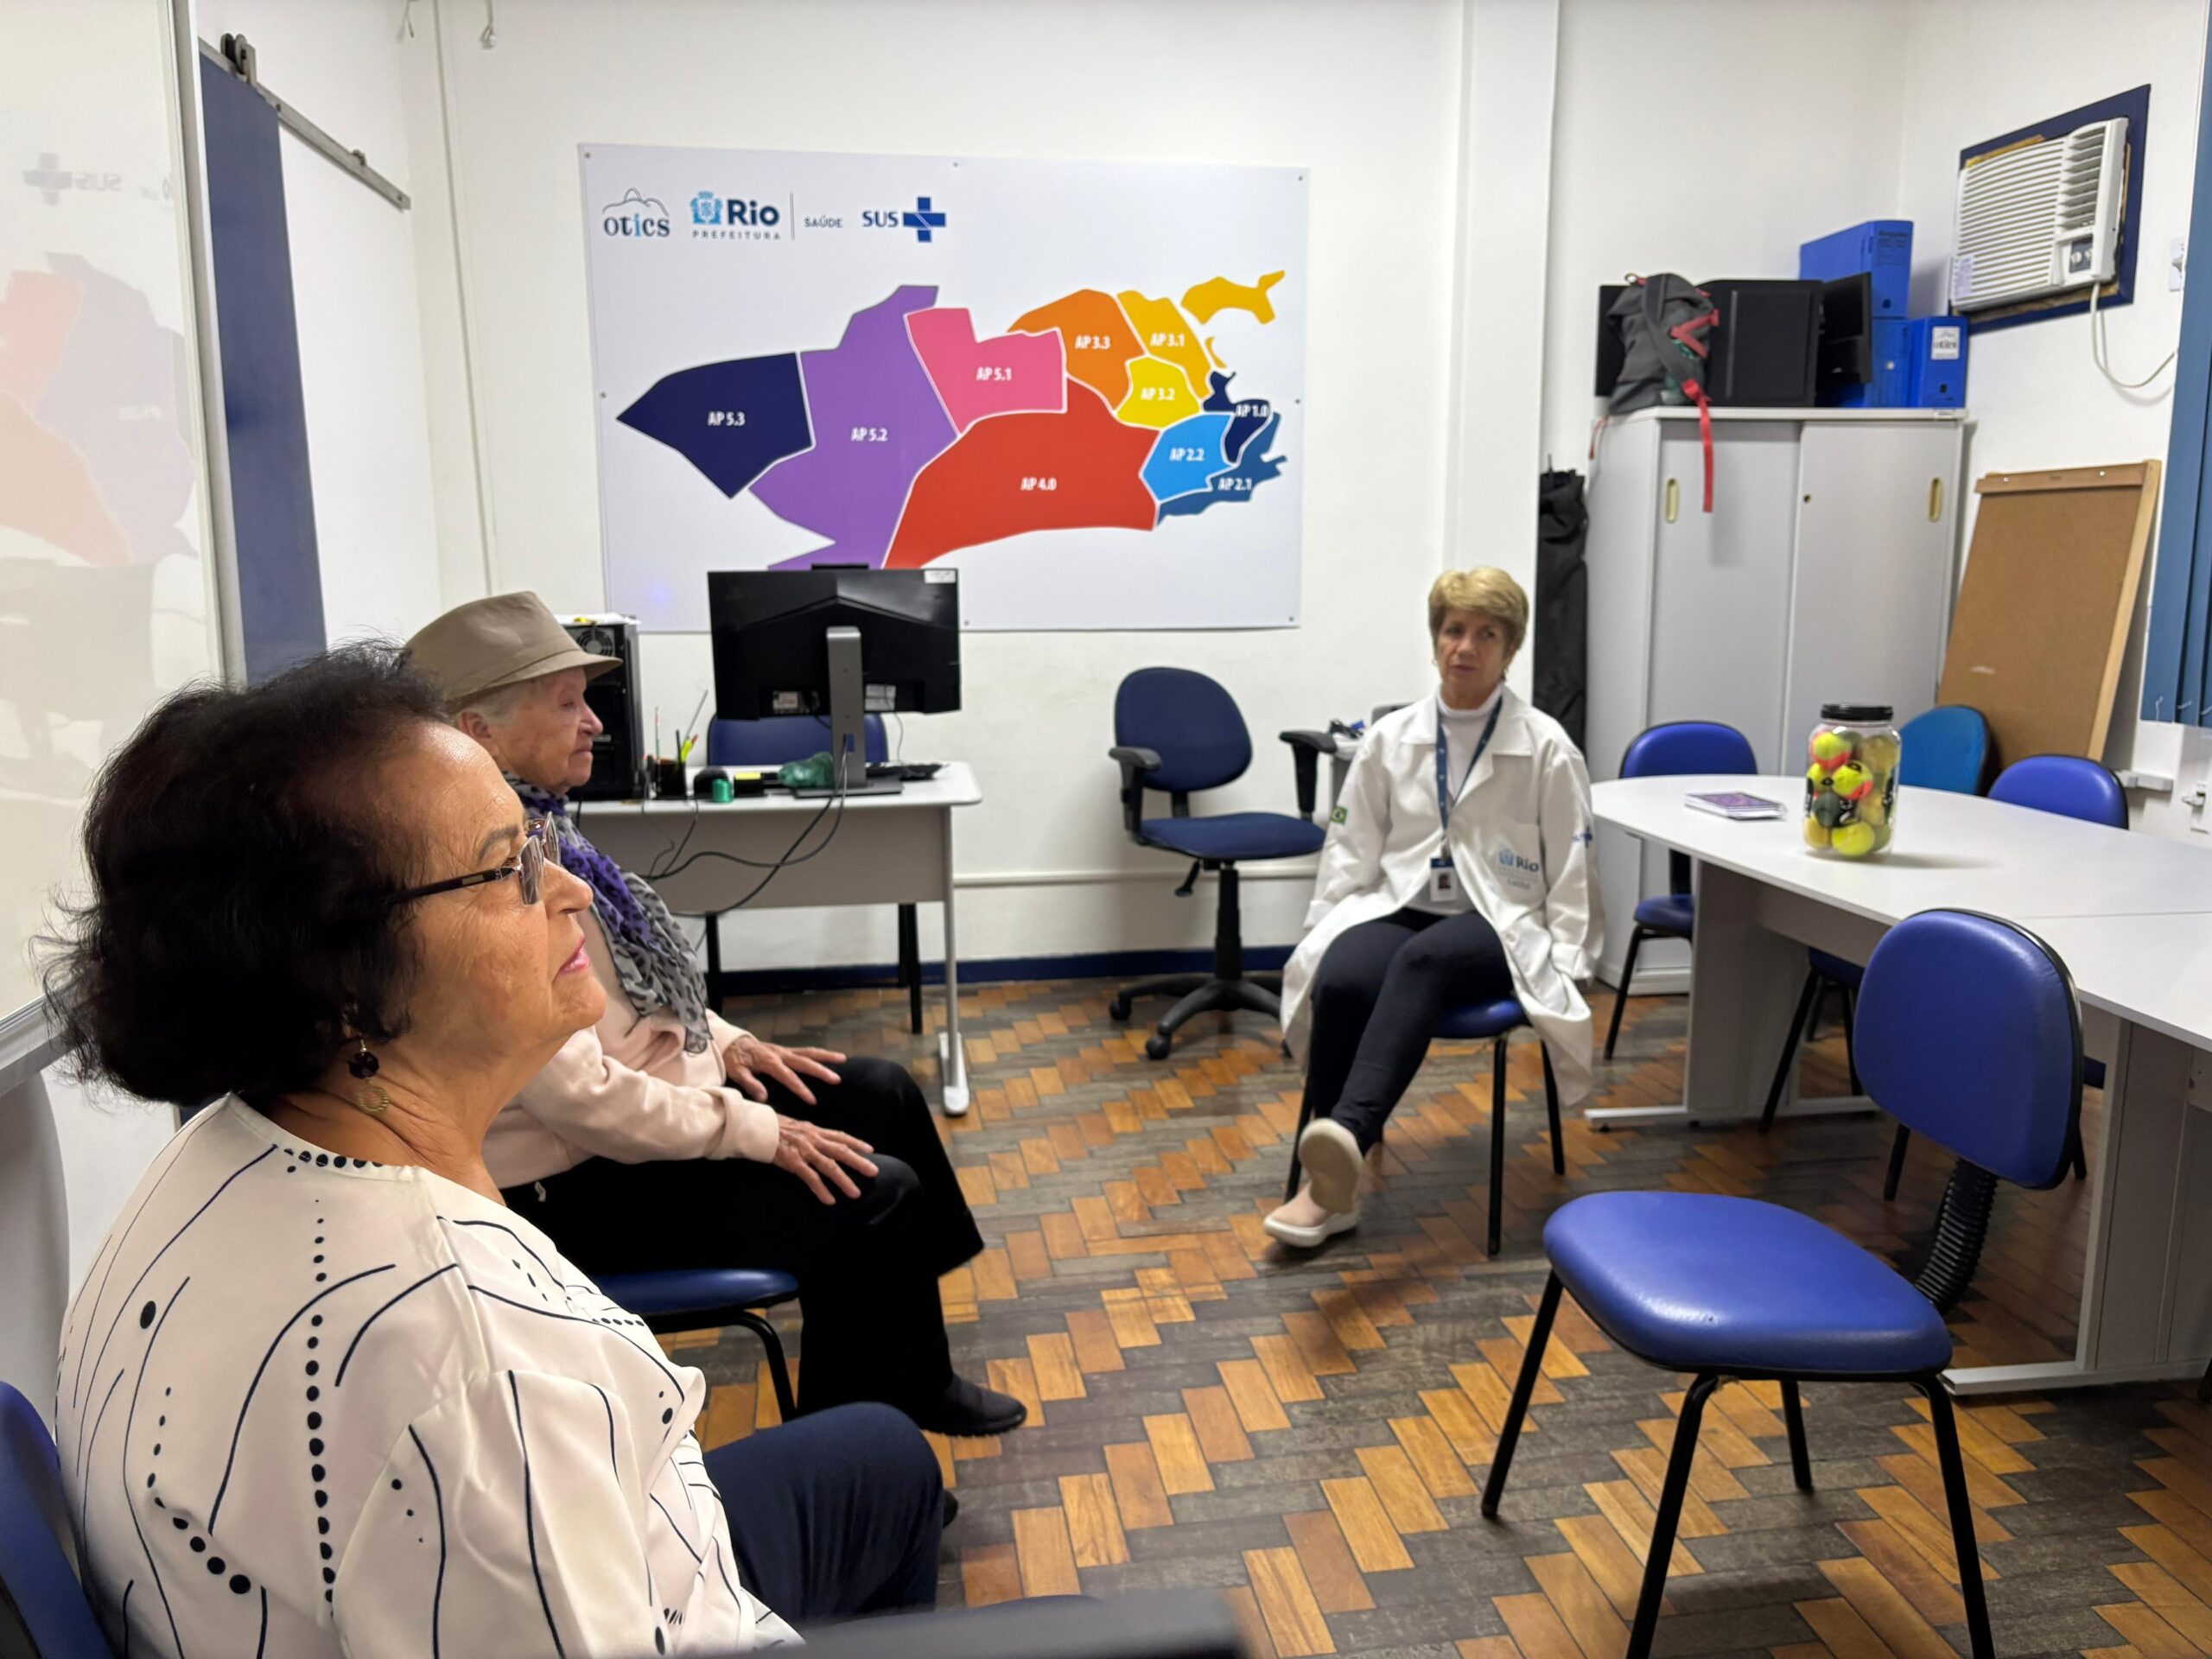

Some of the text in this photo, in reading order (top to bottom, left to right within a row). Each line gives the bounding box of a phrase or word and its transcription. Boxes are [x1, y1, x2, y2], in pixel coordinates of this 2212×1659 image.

[727, 199, 780, 226] Rio
[862, 210, 899, 228] SUS
[604, 213, 671, 237] otics
[804, 215, 843, 228] SAÚDE
[692, 230, 780, 240] PREFEITURA
[1075, 335, 1110, 349] AP 3.3
[1151, 334, 1185, 346] AP 3.1
[976, 367, 1012, 380] AP 5.1
[1141, 388, 1175, 400] AP 3.2
[708, 411, 746, 426] AP 5.3
[851, 428, 887, 442] AP 5.2
[1170, 448, 1205, 461] AP 2.2
[1021, 477, 1057, 491] AP 4.0
[1217, 478, 1252, 491] AP 2.1
